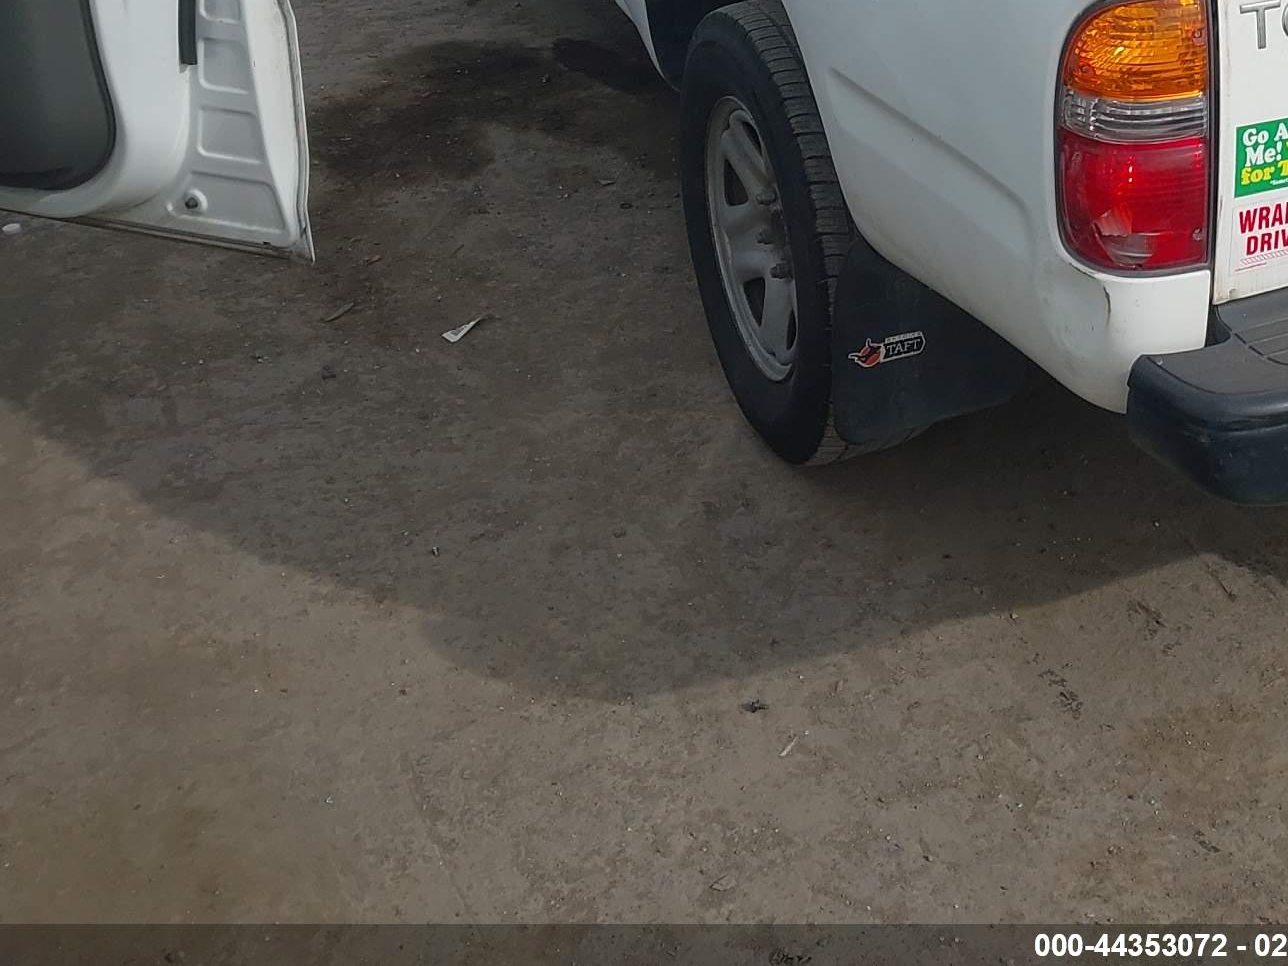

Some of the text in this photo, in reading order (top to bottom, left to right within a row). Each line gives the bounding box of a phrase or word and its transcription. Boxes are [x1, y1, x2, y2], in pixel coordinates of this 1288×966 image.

[1242, 128, 1269, 147] Go
[1245, 141, 1282, 167] Me!
[1241, 165, 1276, 185] for
[887, 339, 920, 355] TAFT
